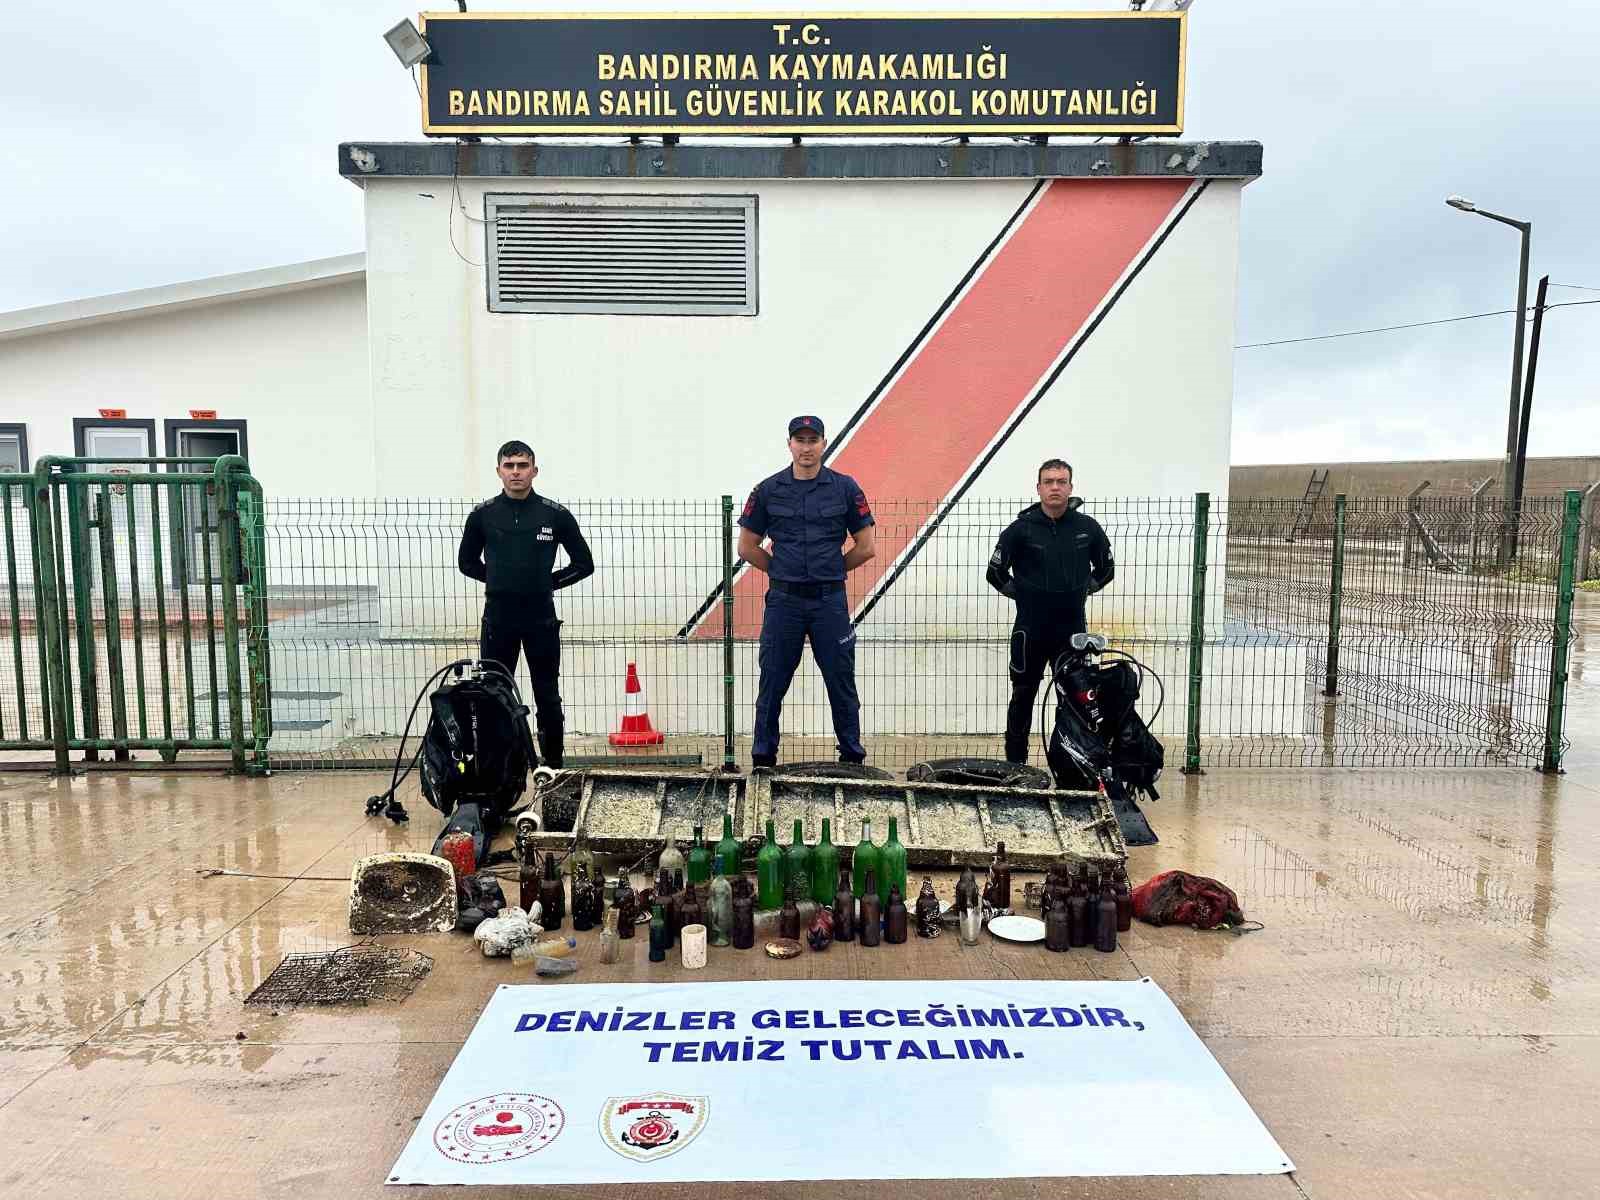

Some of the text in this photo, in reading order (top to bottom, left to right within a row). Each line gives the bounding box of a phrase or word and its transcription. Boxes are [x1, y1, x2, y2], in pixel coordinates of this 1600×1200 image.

[773, 24, 830, 46] T.C.
[597, 45, 1007, 81] BANDIRMA KAYMAKAMLIĞI
[448, 81, 1157, 117] BANDIRMA SAHİL GÜVENLİK KARAKOL KOMUTANLIĞI
[514, 1004, 1145, 1033] DENİZLER GELECEĞİMİZDİR,
[643, 1037, 1024, 1063] TEMİZ TUTALIM.
